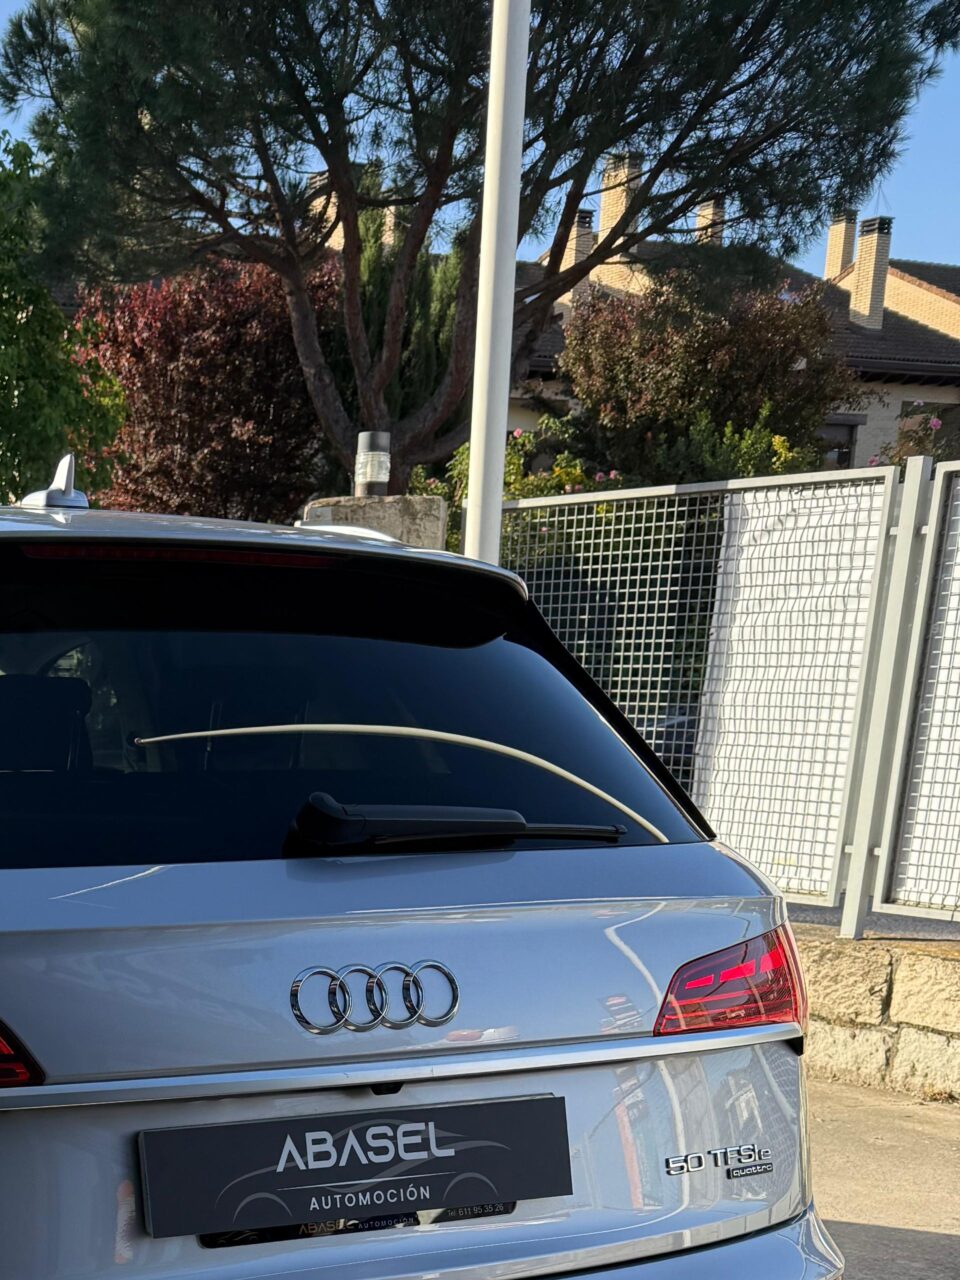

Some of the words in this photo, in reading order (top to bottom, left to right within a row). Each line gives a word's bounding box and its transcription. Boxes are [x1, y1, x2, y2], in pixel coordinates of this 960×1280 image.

[276, 1121, 456, 1173] ABASEL
[666, 1152, 705, 1176] 50
[732, 1164, 773, 1177] quattro
[309, 1183, 431, 1211] AUTOMOCIÓN
[458, 1207, 472, 1216] 611
[473, 1206, 483, 1214] 95
[484, 1204, 494, 1213] 35
